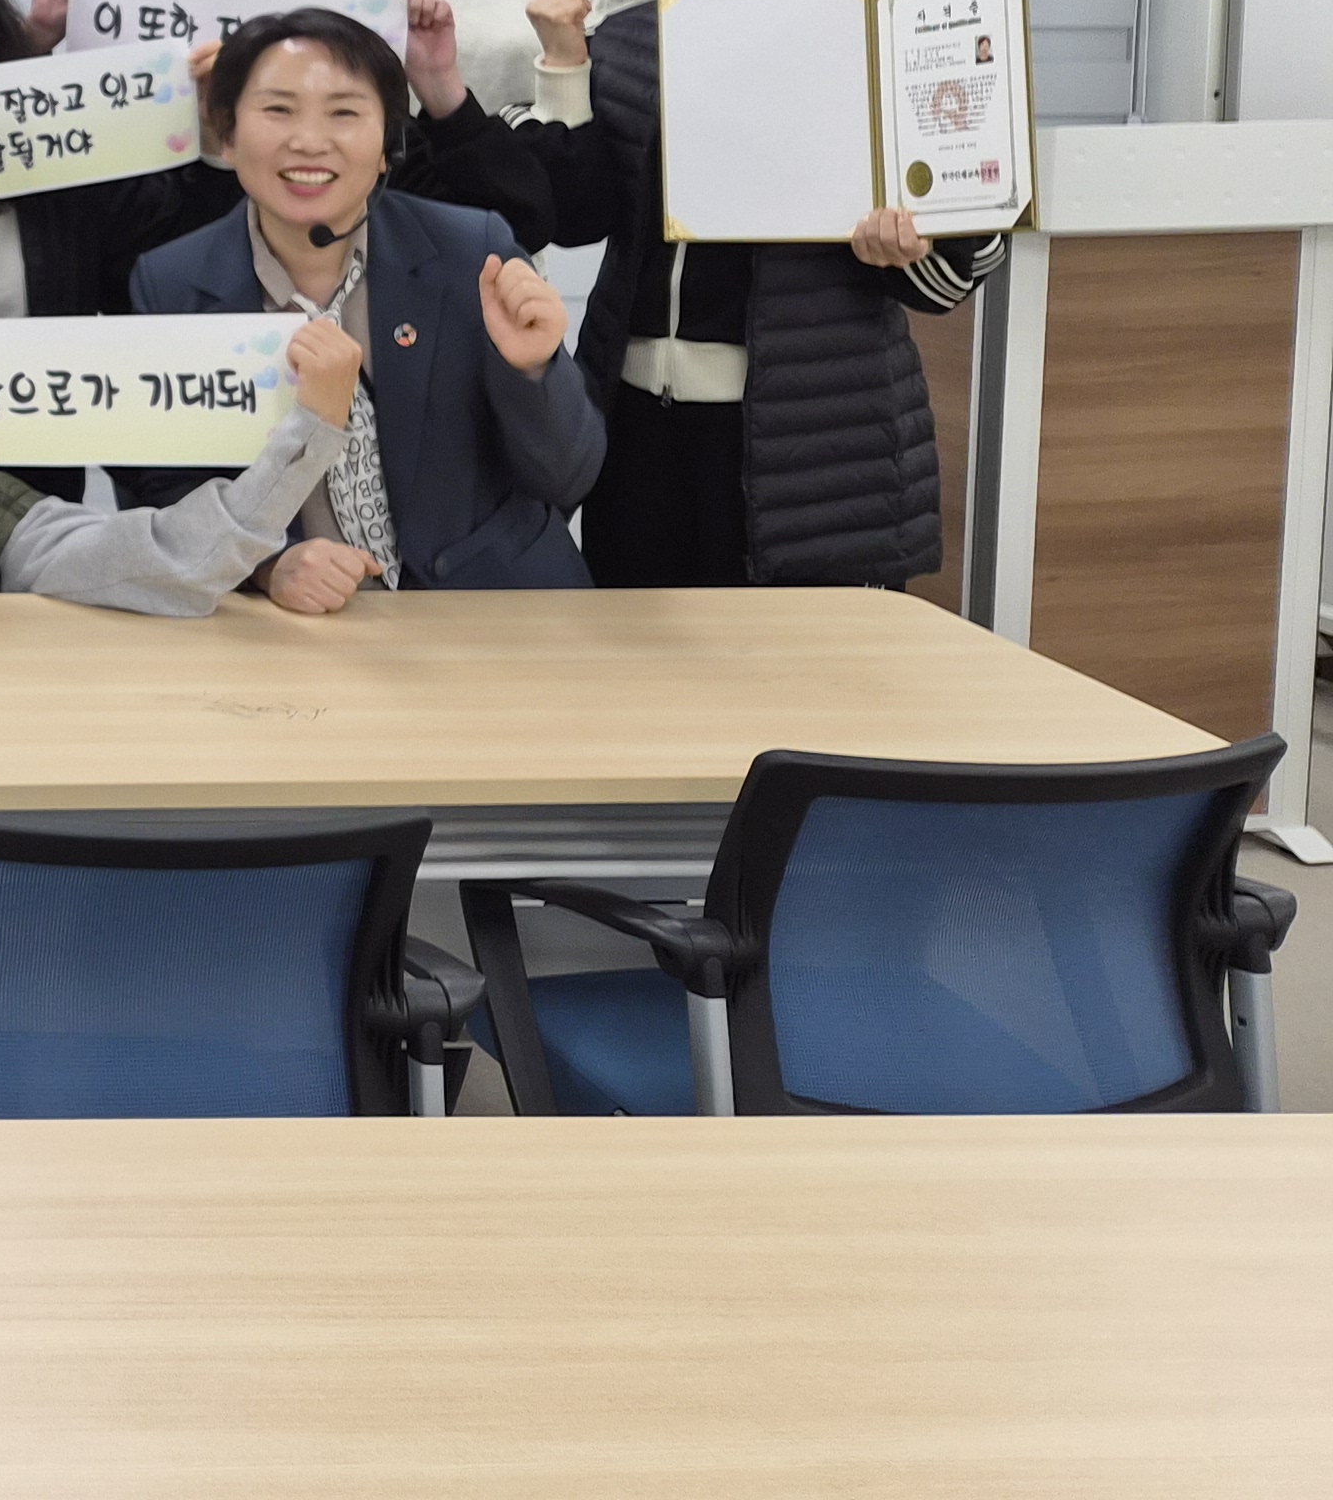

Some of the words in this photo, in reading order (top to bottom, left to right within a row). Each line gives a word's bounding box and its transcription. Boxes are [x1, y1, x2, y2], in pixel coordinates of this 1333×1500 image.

[93, 1, 122, 40] 이
[99, 72, 155, 109] 있고
[138, 368, 257, 414] 기대돼
